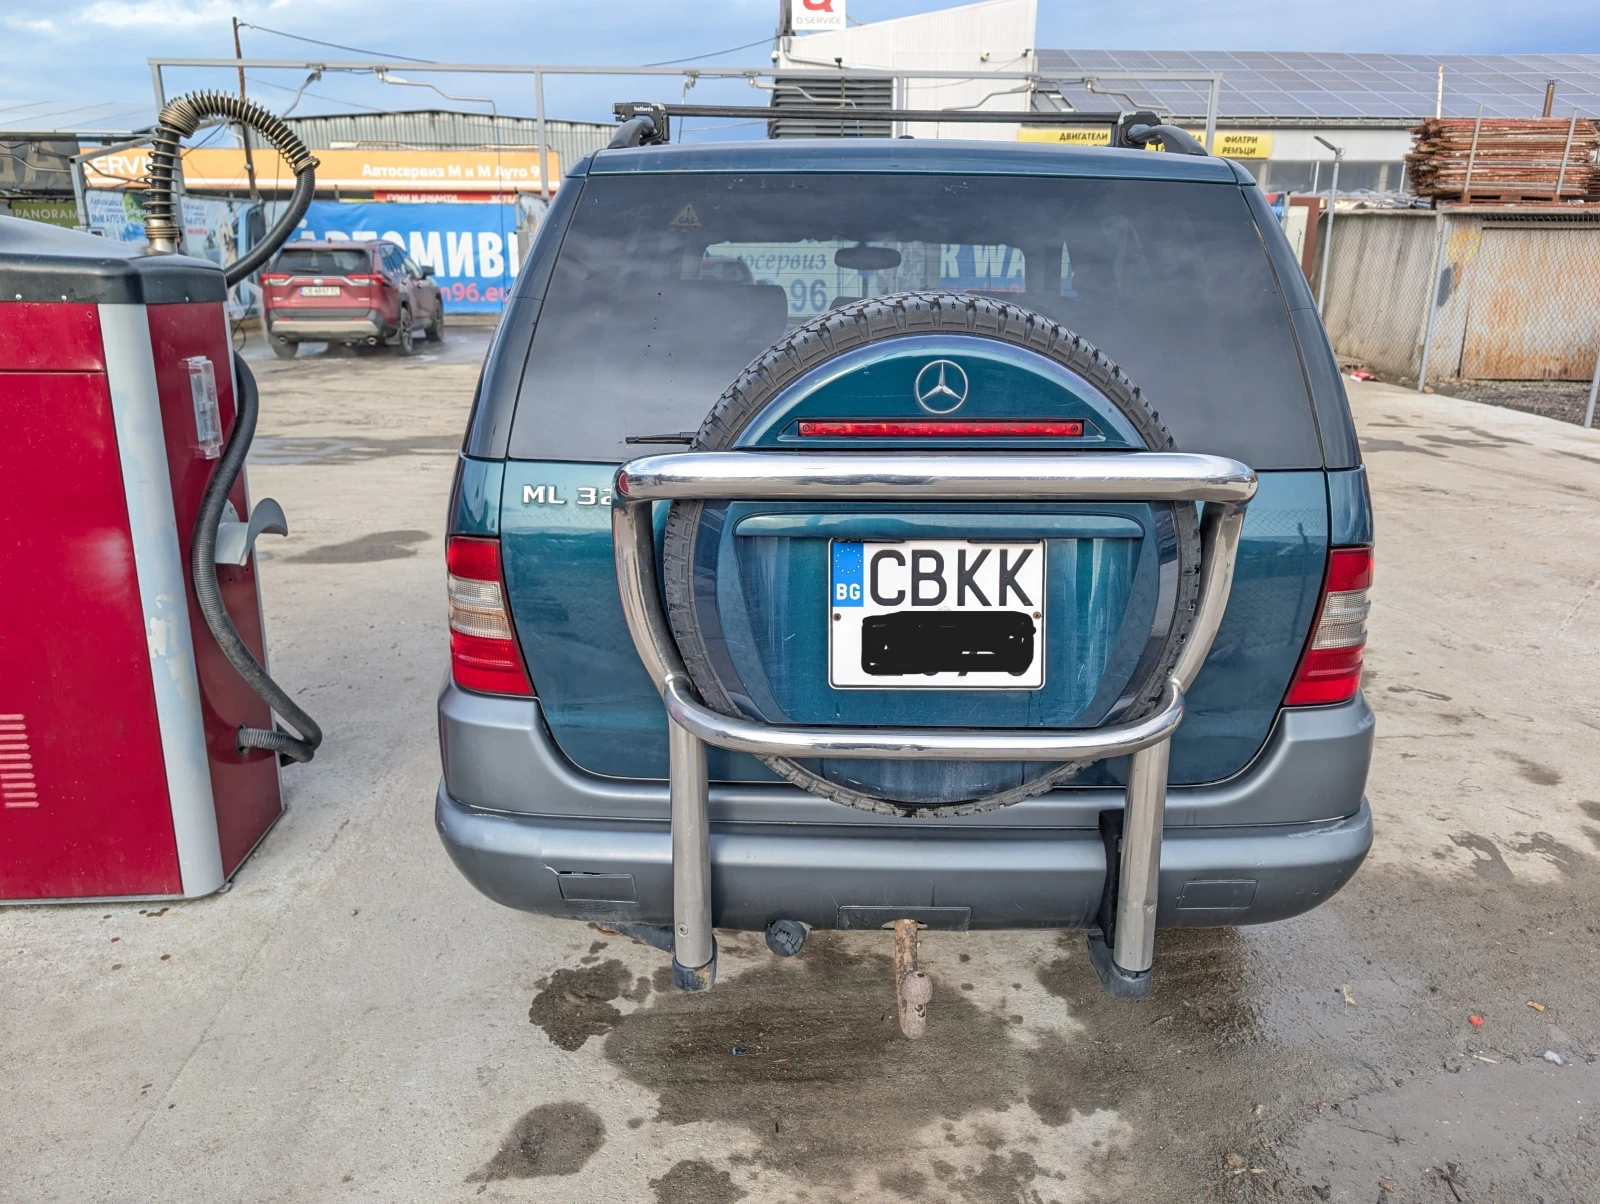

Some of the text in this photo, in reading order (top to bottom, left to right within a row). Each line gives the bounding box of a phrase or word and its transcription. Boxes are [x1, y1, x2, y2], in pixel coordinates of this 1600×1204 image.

[804, 16, 841, 24] SERVICE
[1059, 132, 1108, 141] ДВИГАТЕЛИ
[1224, 136, 1258, 144] ФИЛТРИ
[1221, 147, 1256, 155] РЕМЪЦИ
[83, 155, 153, 175] SERVI
[362, 164, 444, 179] Автосервиз
[449, 165, 461, 177] М
[466, 167, 474, 176] и
[478, 165, 491, 178] М
[494, 165, 528, 180] Ауто
[678, 216, 695, 225] GAS
[790, 278, 827, 313] 96
[523, 485, 567, 504] ML
[870, 548, 1034, 607] CBKK
[836, 583, 861, 601] BG
